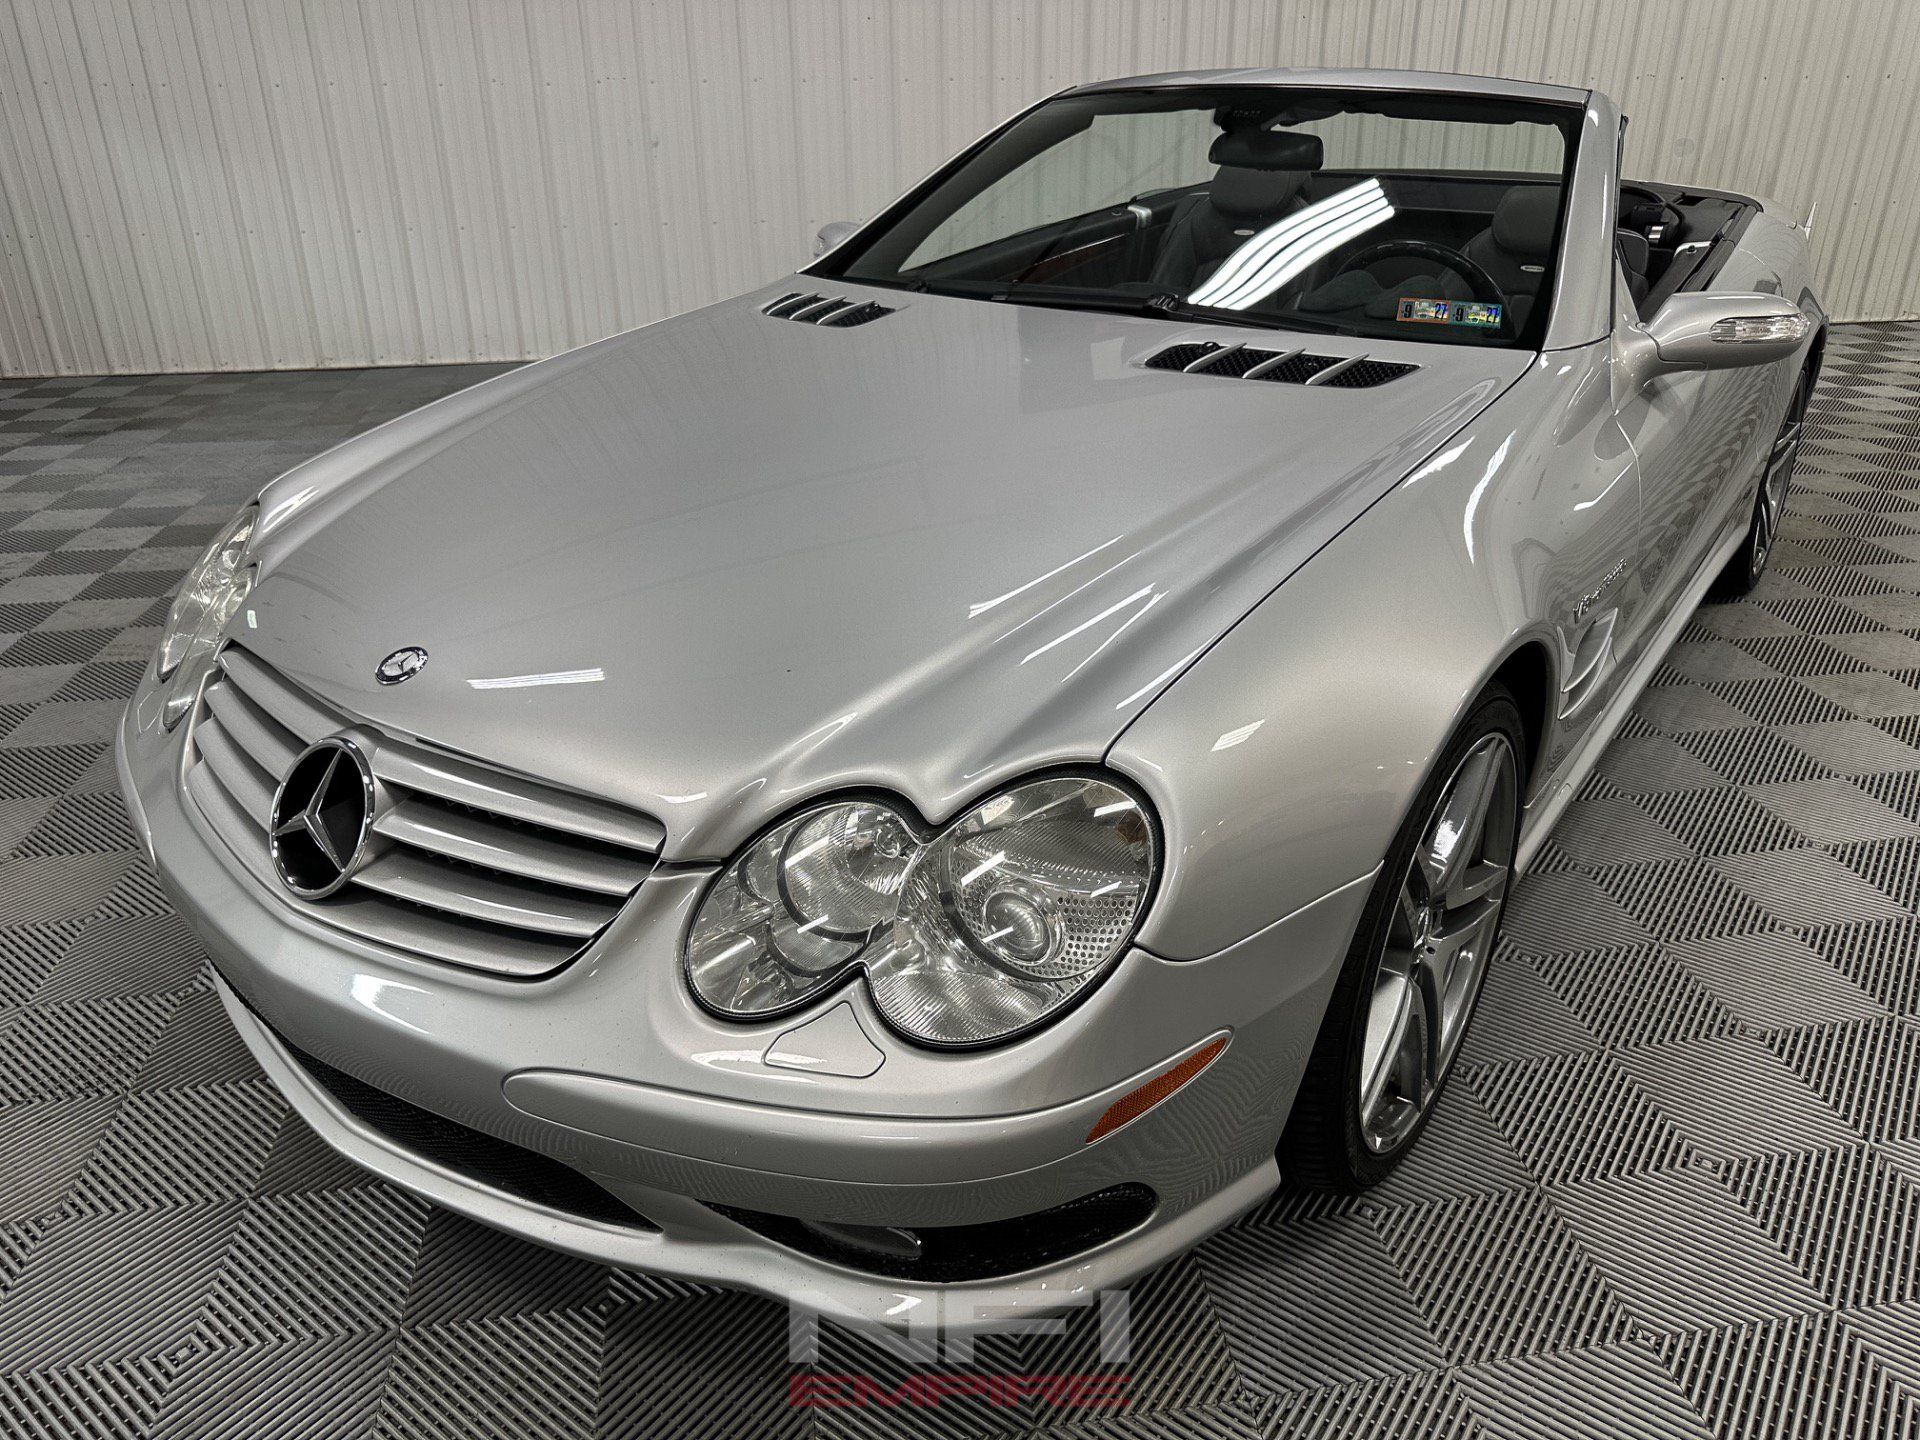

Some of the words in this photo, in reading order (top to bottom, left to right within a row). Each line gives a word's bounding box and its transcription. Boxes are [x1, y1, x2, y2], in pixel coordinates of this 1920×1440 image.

[1403, 304, 1412, 318] 9
[1434, 303, 1447, 319] 27
[1455, 307, 1464, 322] 9
[1486, 306, 1499, 323] 27
